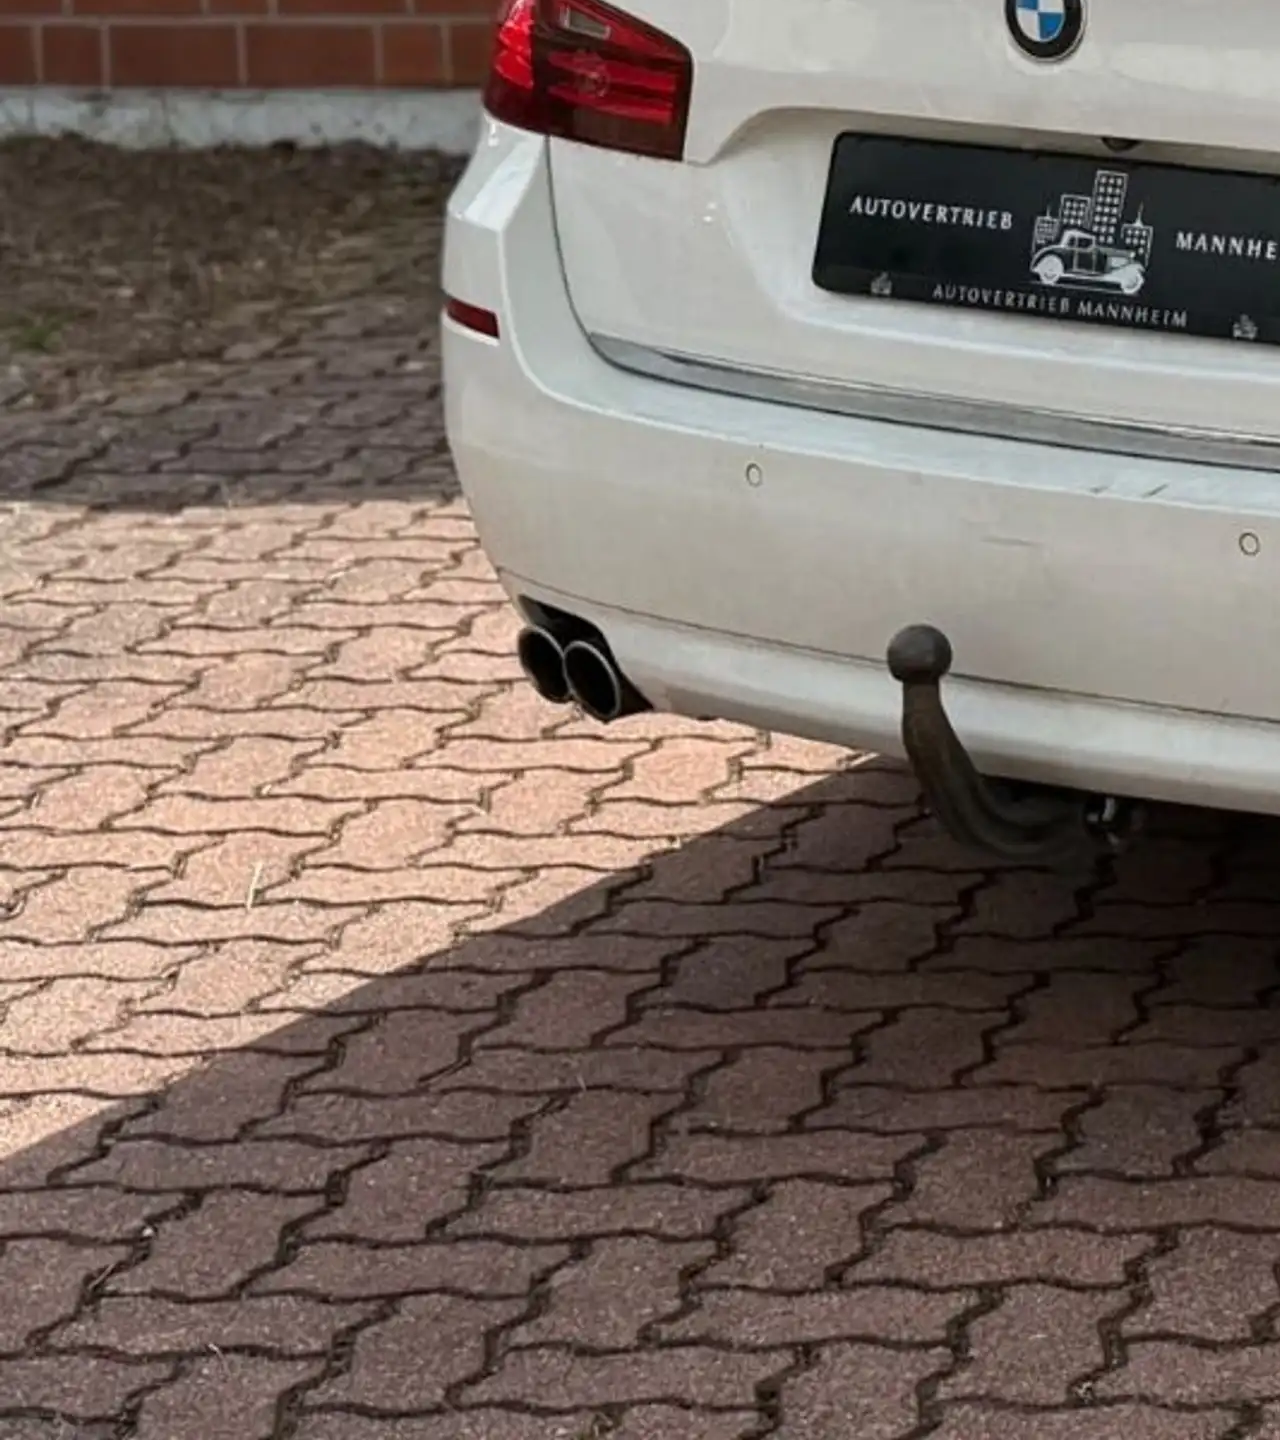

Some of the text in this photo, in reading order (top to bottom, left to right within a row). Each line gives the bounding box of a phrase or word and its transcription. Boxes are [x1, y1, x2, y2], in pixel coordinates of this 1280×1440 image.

[849, 195, 1013, 230] AUTOVERTRIEB
[932, 283, 1188, 329] AUTOVERTRIEB MANNHEIM
